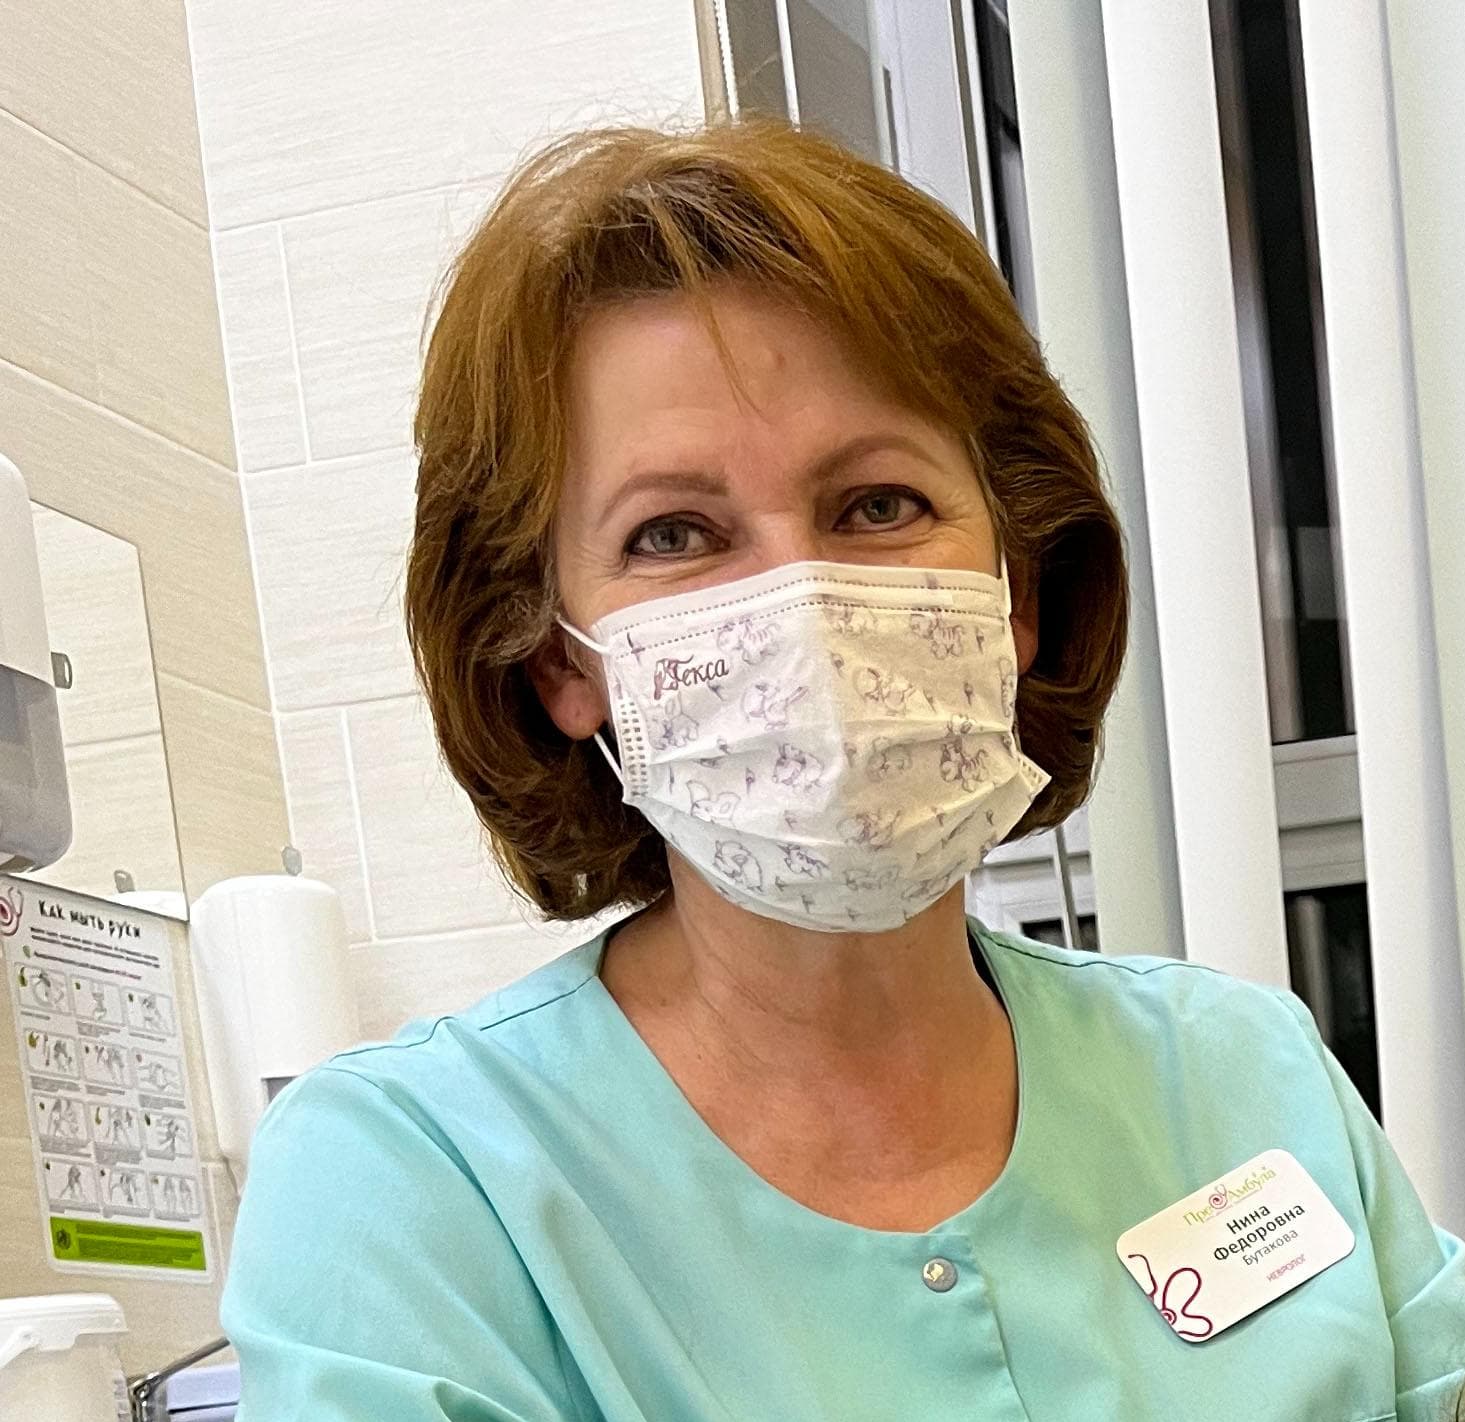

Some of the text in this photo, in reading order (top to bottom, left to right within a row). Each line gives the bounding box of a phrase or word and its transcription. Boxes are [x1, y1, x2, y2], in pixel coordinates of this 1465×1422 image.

[1213, 1205, 1305, 1261] Федоровна
[1226, 1205, 1271, 1235] Нина
[1242, 1229, 1299, 1266] Бутакова
